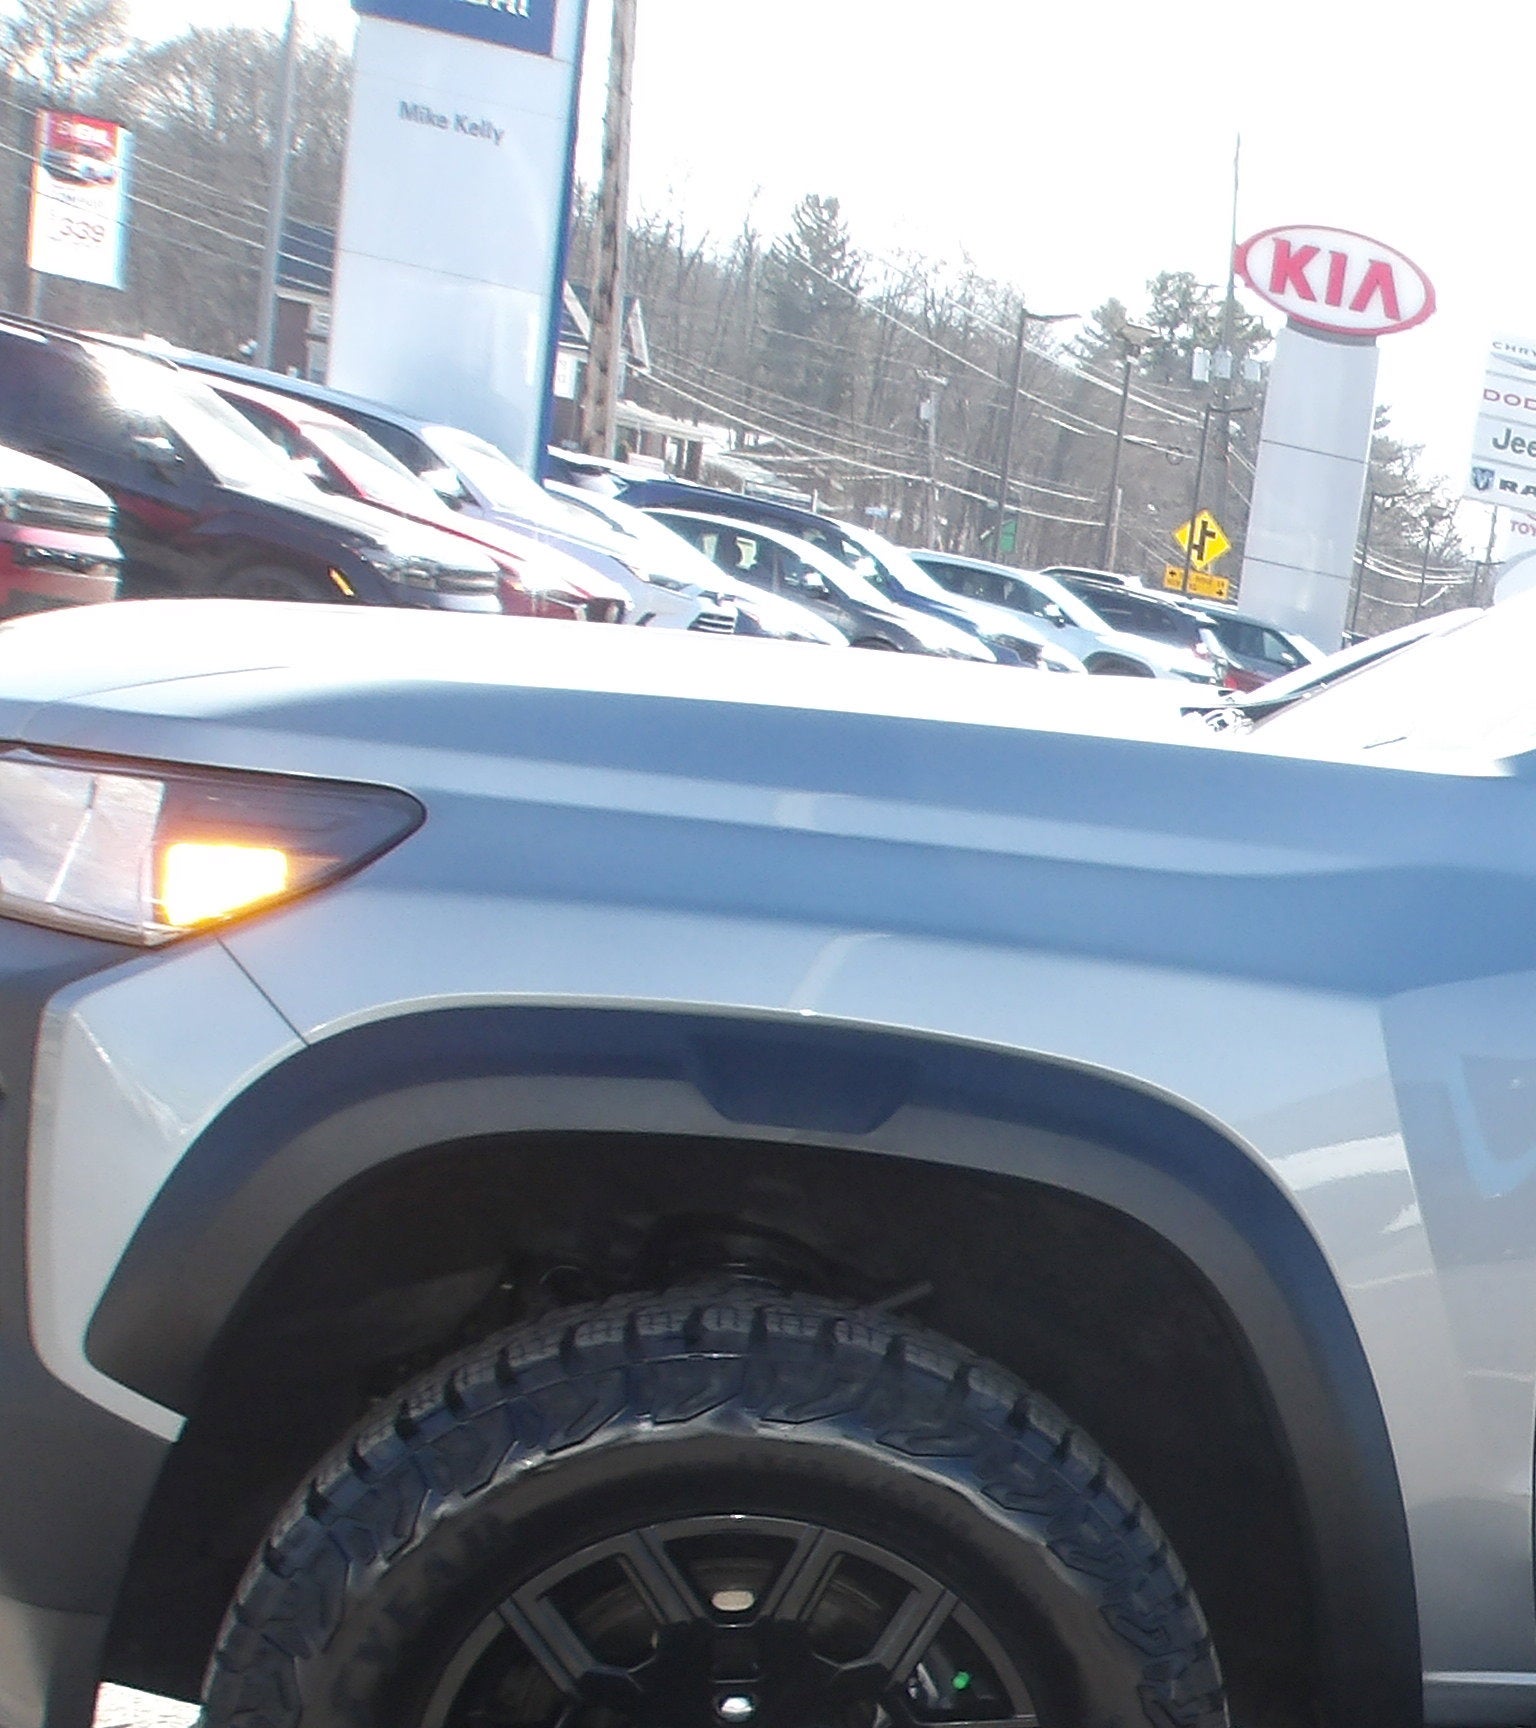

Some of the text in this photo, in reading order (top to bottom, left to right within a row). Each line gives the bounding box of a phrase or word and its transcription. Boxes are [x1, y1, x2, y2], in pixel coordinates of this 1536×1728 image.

[398, 100, 504, 146] Mike Kelly
[1269, 236, 1401, 322] KIA
